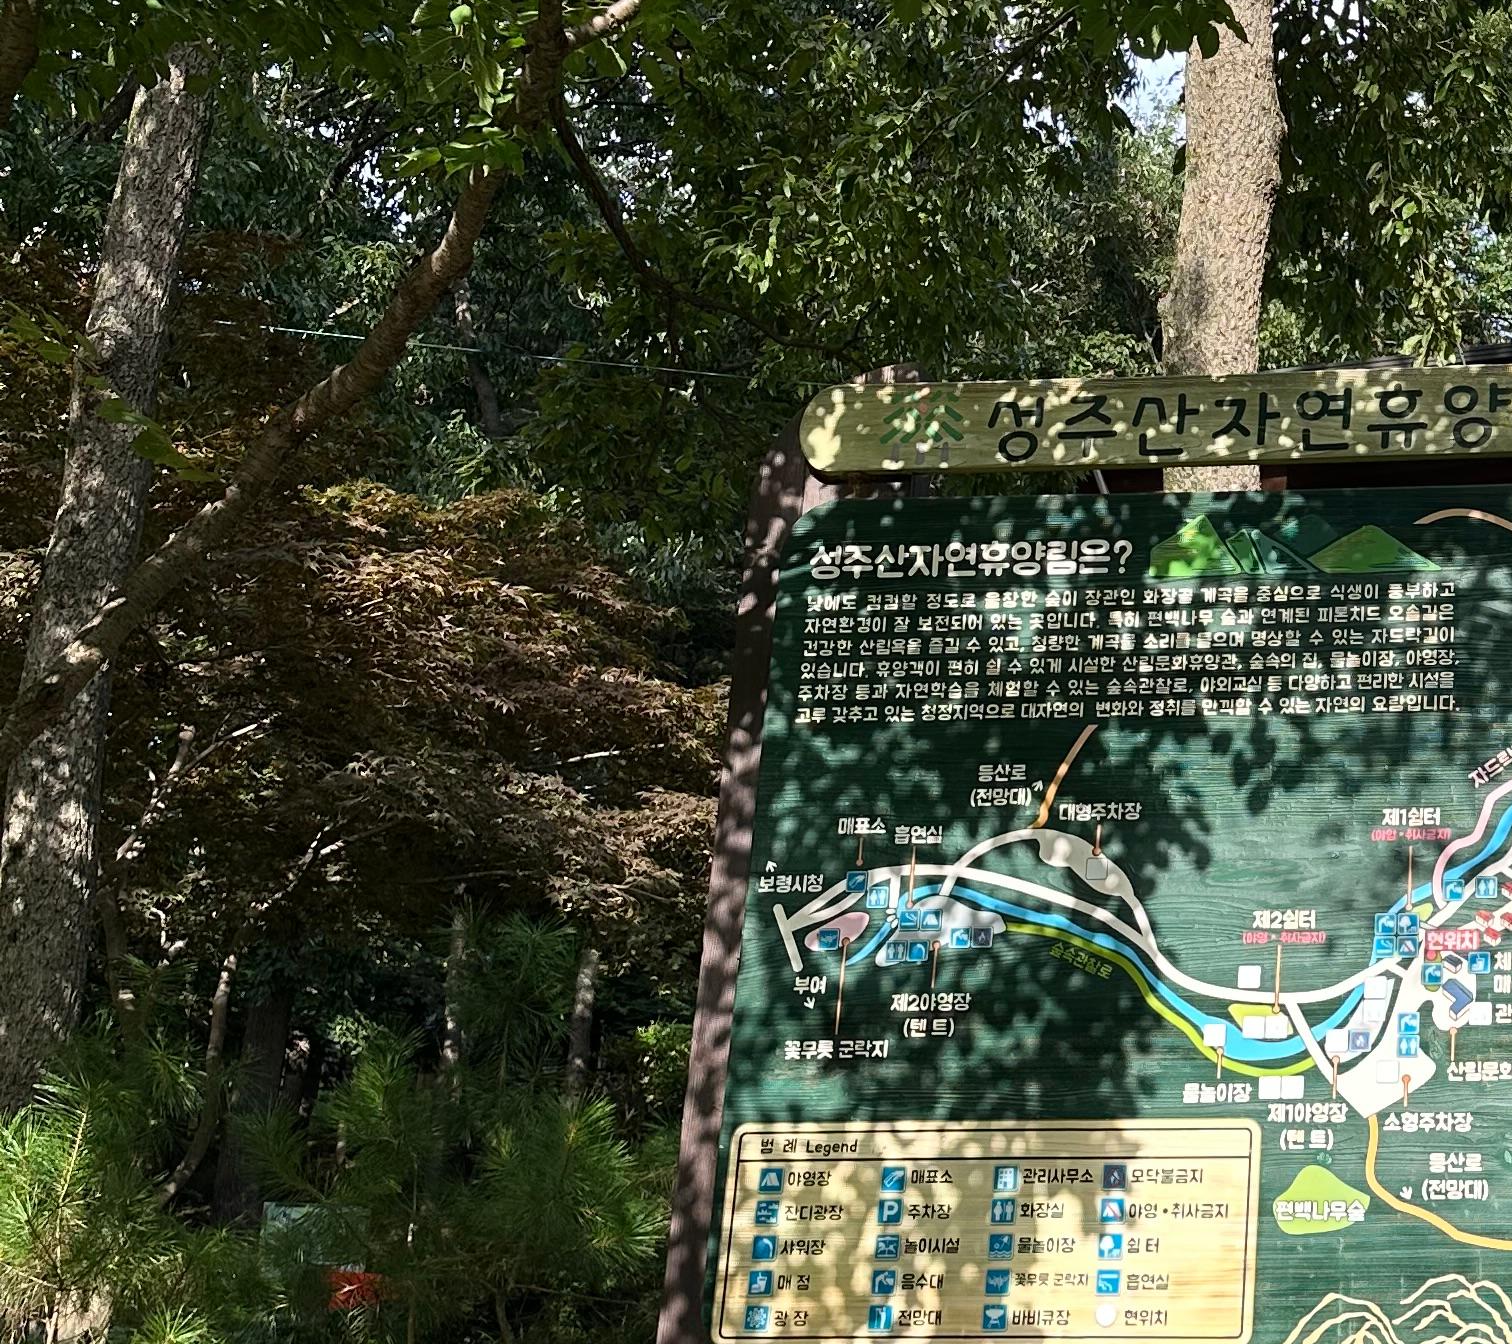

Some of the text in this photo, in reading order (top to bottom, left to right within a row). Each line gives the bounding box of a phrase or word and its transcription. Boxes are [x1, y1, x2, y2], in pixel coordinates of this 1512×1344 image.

[810, 539, 1133, 579] 성주산자연휴양림은?
[927, 593, 975, 611] 정도로
[1257, 586, 1321, 602] 중심으로
[798, 685, 847, 701] 주차장
[978, 764, 1026, 781] 등산로
[838, 817, 886, 834] 매표소
[758, 874, 824, 893] 보령시청
[806, 1139, 858, 1156] Legend
[787, 1170, 832, 1187] 야영장
[911, 1168, 953, 1185] 매표소
[1022, 1167, 1094, 1185] 관리사무소
[908, 1203, 952, 1220] 주차장
[1020, 1202, 1064, 1220] 화장실
